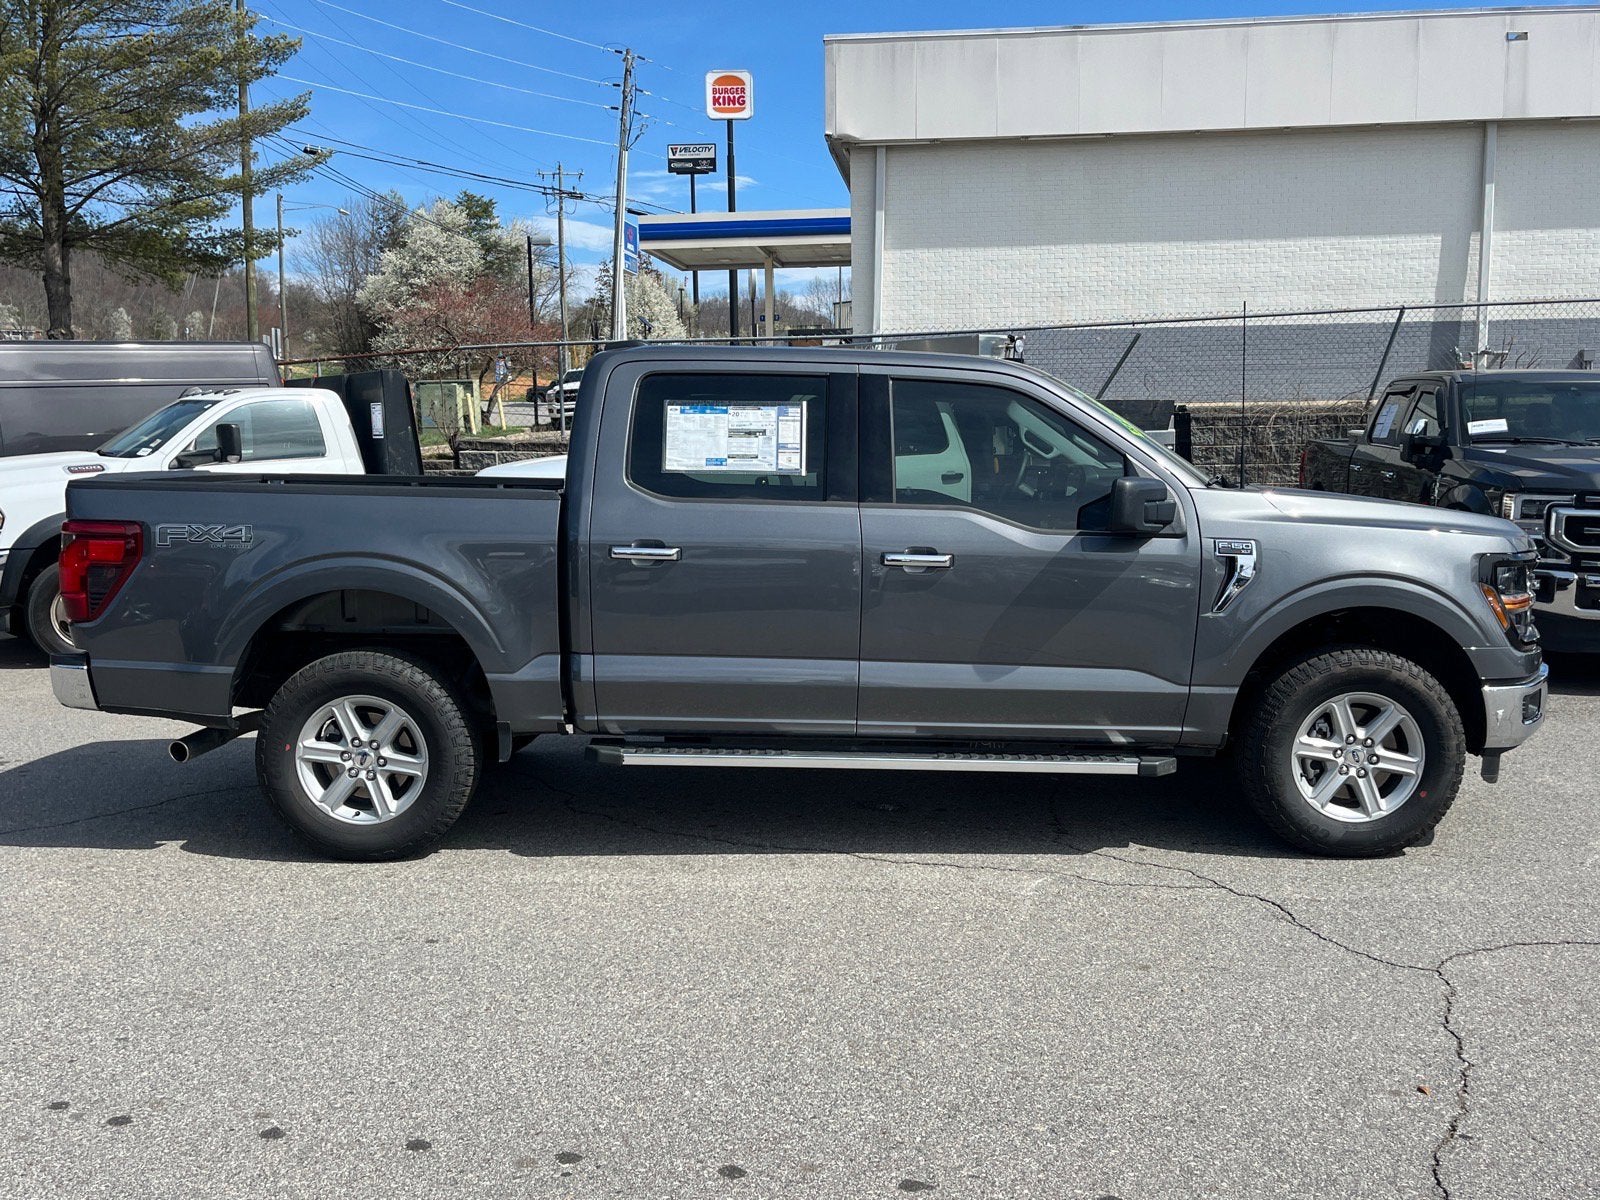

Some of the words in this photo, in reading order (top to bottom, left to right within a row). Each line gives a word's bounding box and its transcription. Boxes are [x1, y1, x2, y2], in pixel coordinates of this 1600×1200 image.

[712, 87, 746, 95] BURGER
[712, 95, 746, 106] KING
[155, 523, 254, 548] FX4
